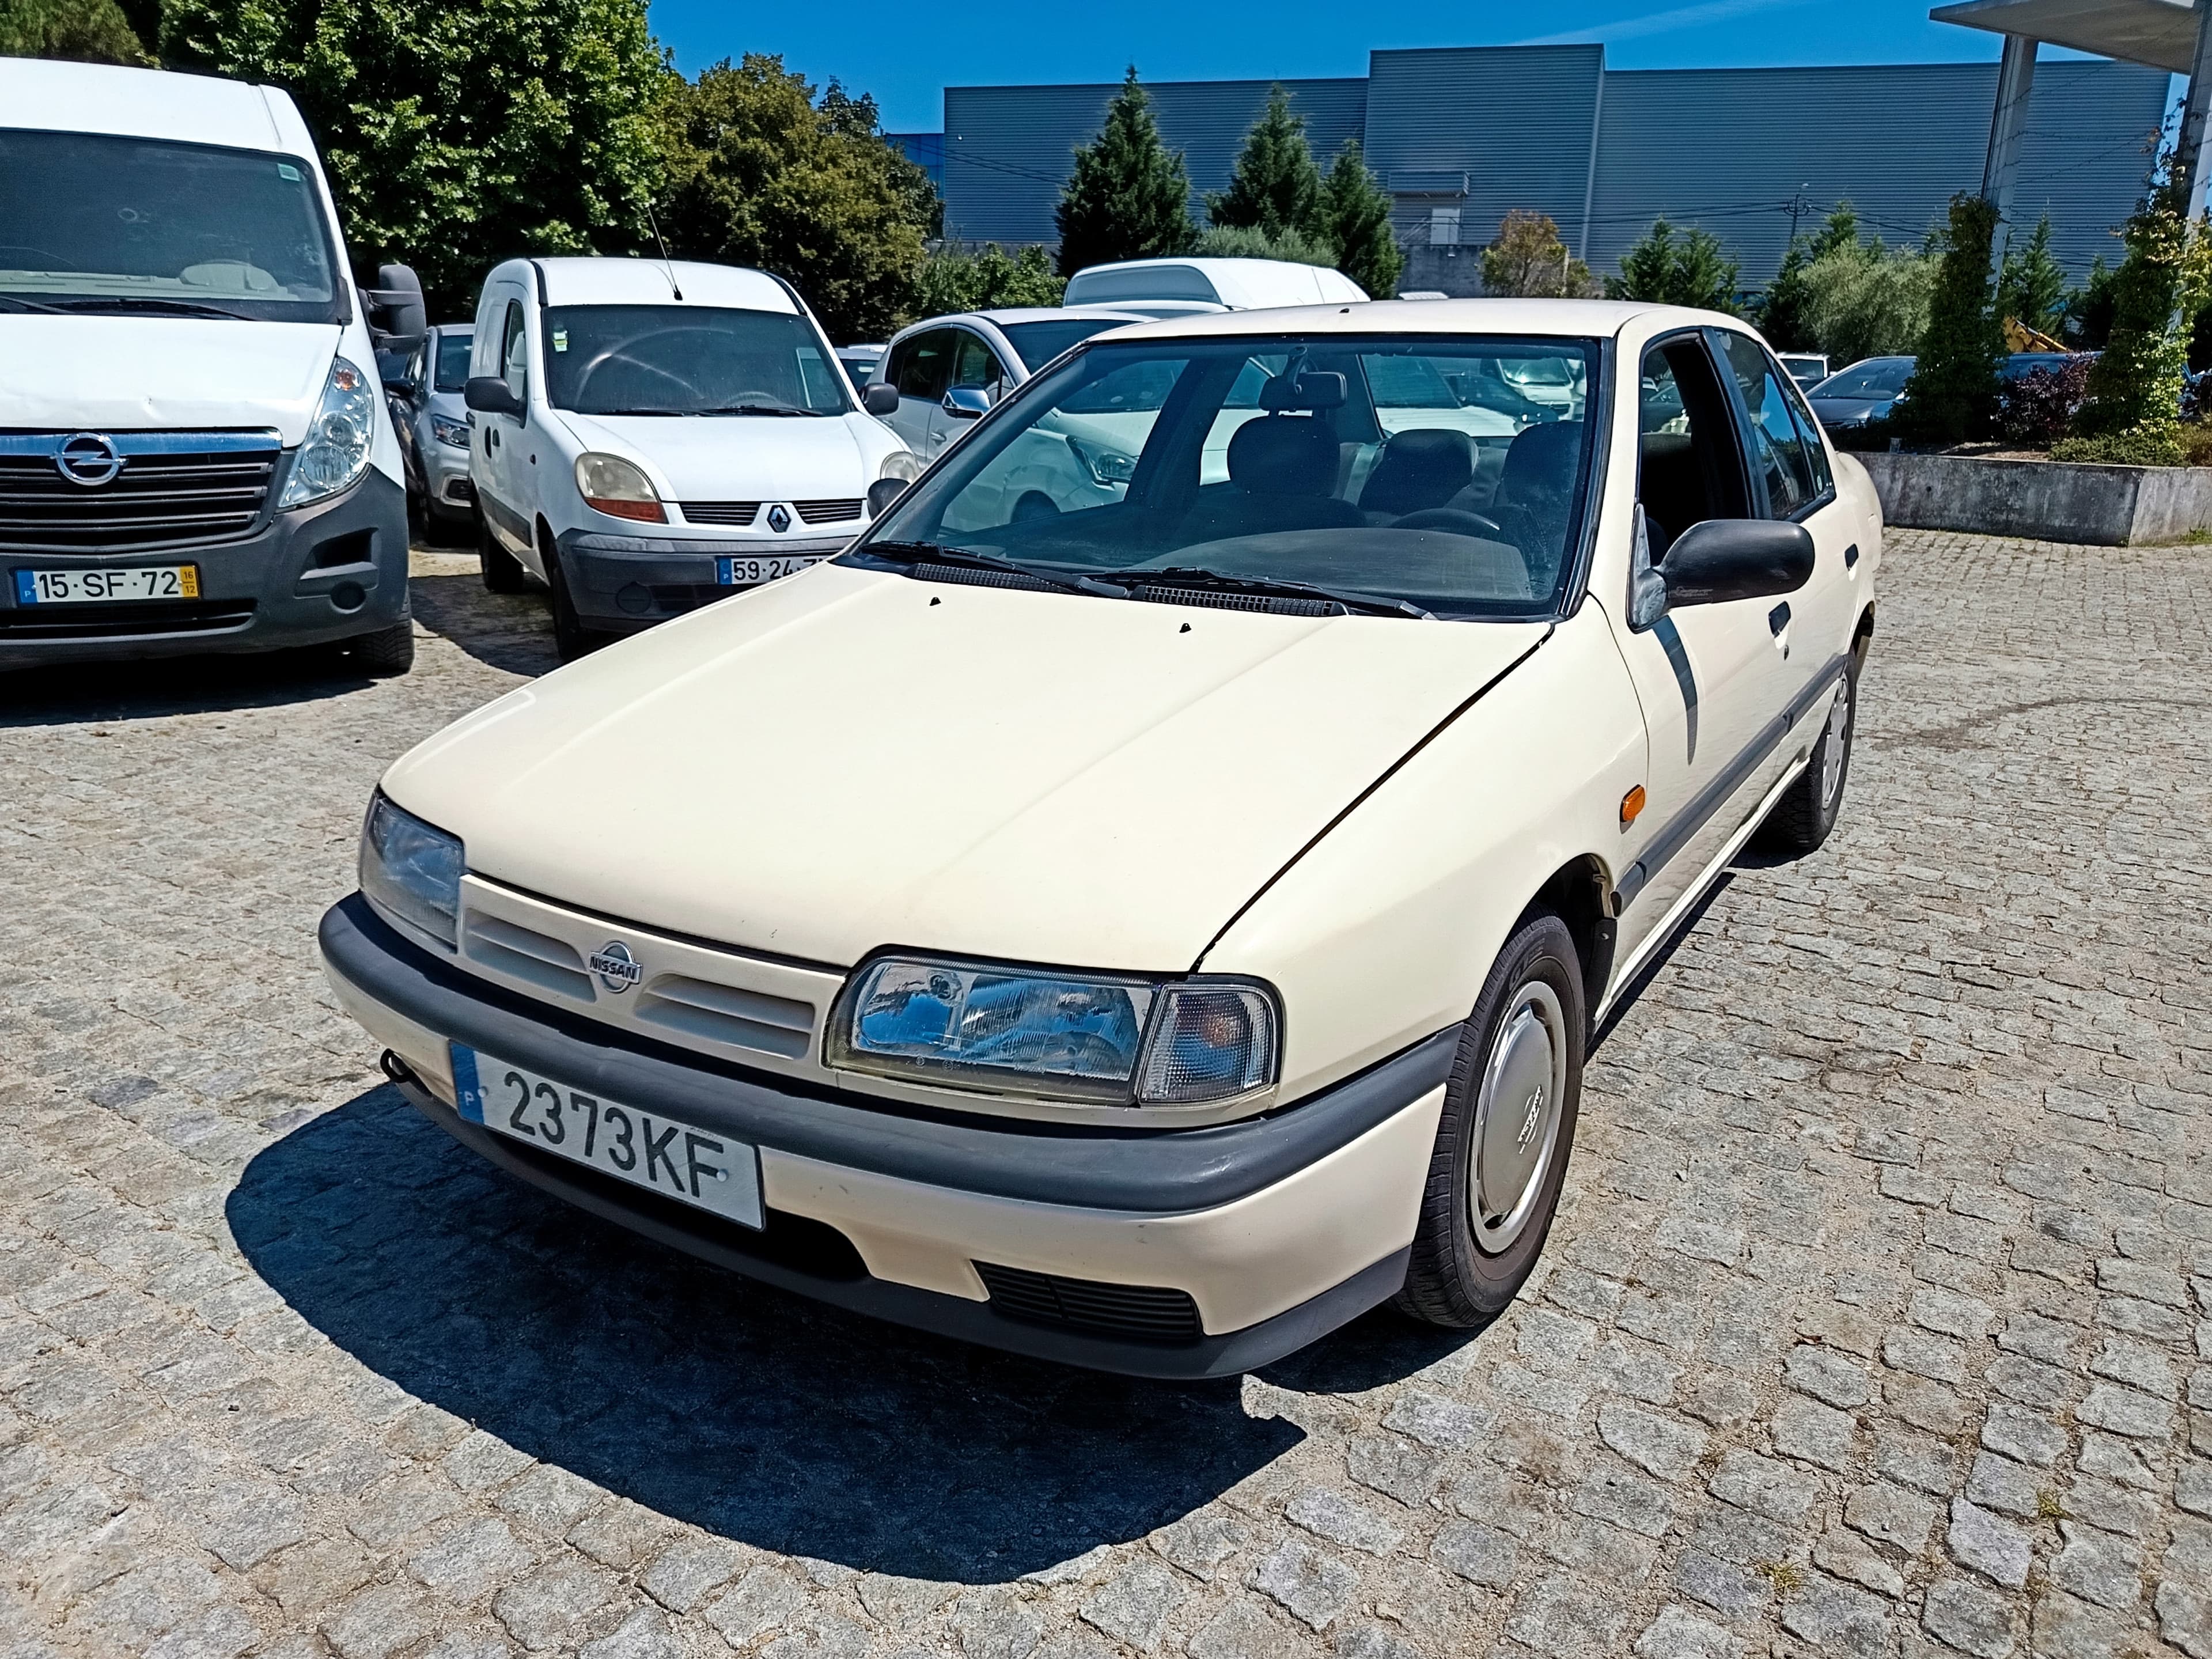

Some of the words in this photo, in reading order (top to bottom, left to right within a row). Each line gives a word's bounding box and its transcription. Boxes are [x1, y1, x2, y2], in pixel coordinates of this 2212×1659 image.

[184, 571, 194, 580] 16
[186, 585, 196, 594] 12
[589, 956, 637, 980] NISSAN
[464, 1090, 475, 1107] P
[503, 1071, 725, 1198] 2373KF
